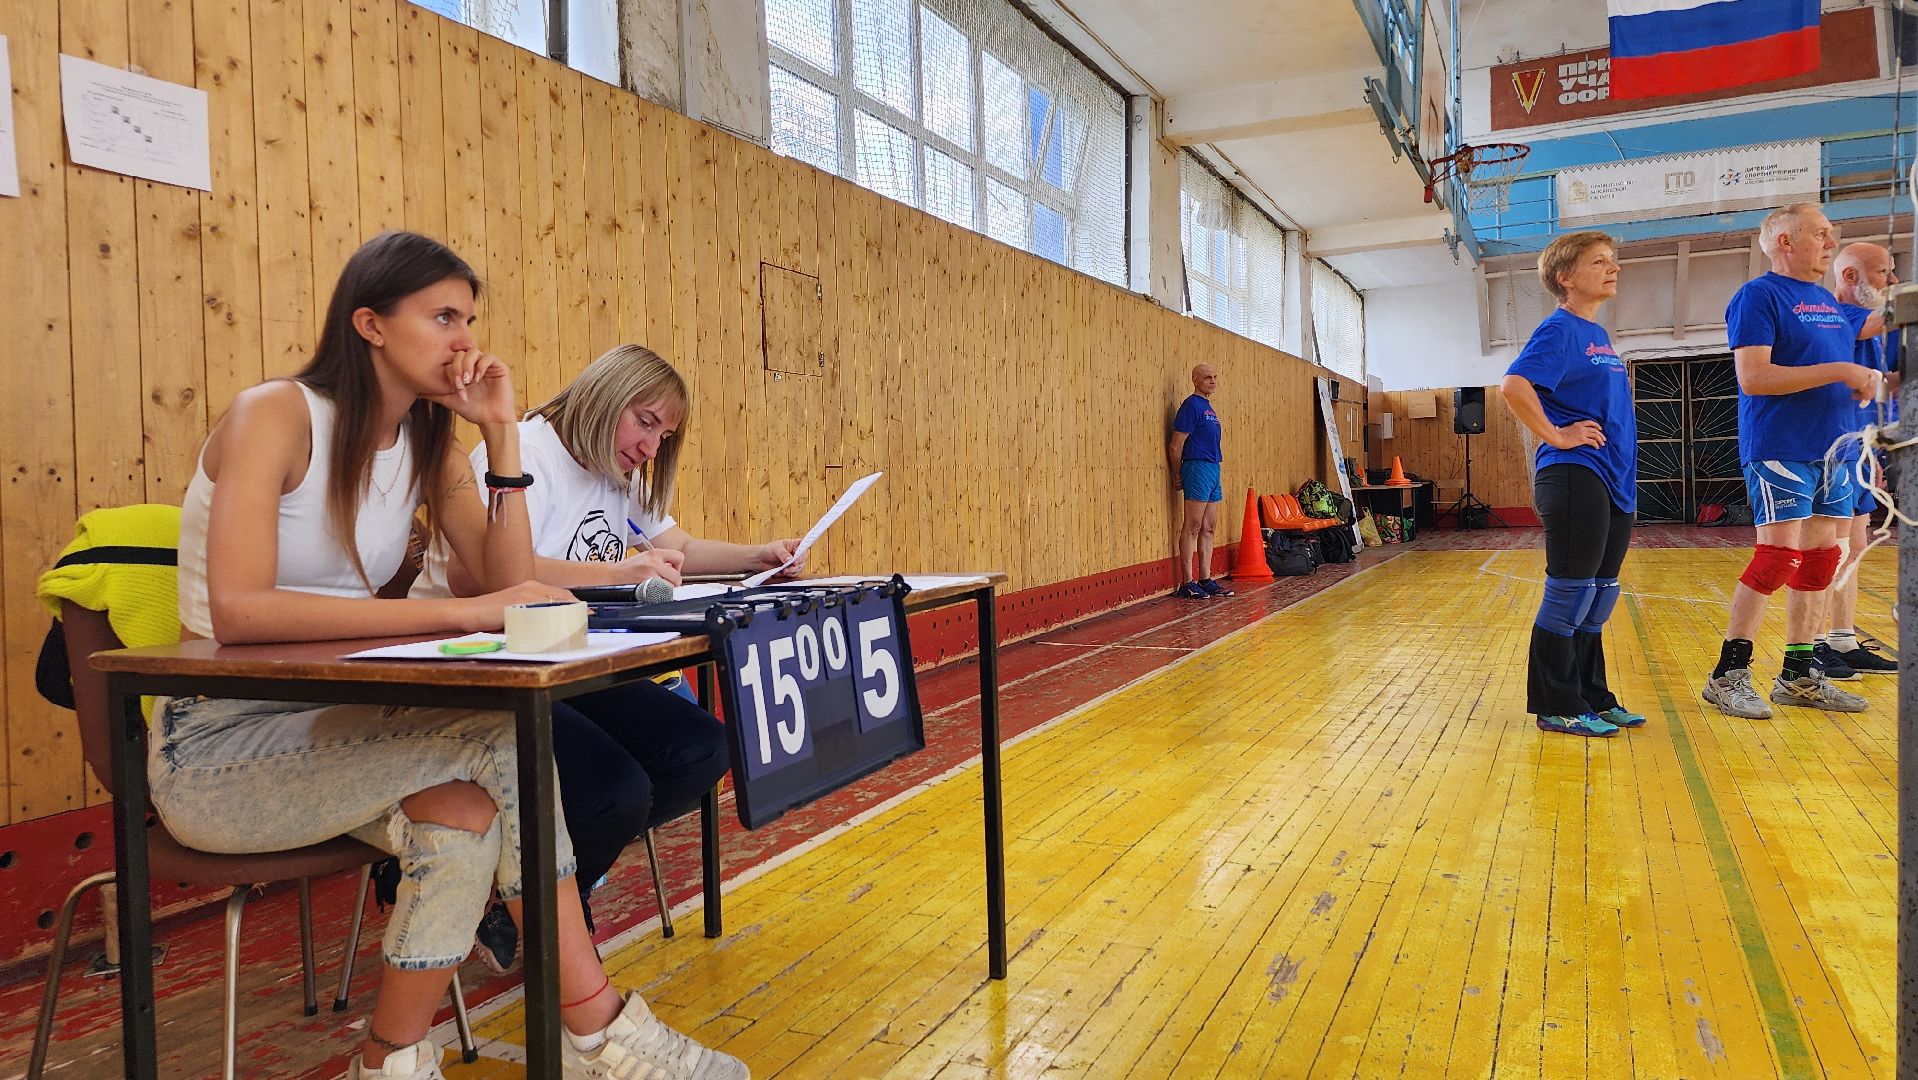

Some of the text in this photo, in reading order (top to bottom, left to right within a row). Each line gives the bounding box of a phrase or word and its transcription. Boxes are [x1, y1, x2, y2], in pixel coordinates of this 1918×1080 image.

[1664, 170, 1696, 190] ГТО
[739, 636, 806, 765] 15
[858, 615, 900, 719] 5
